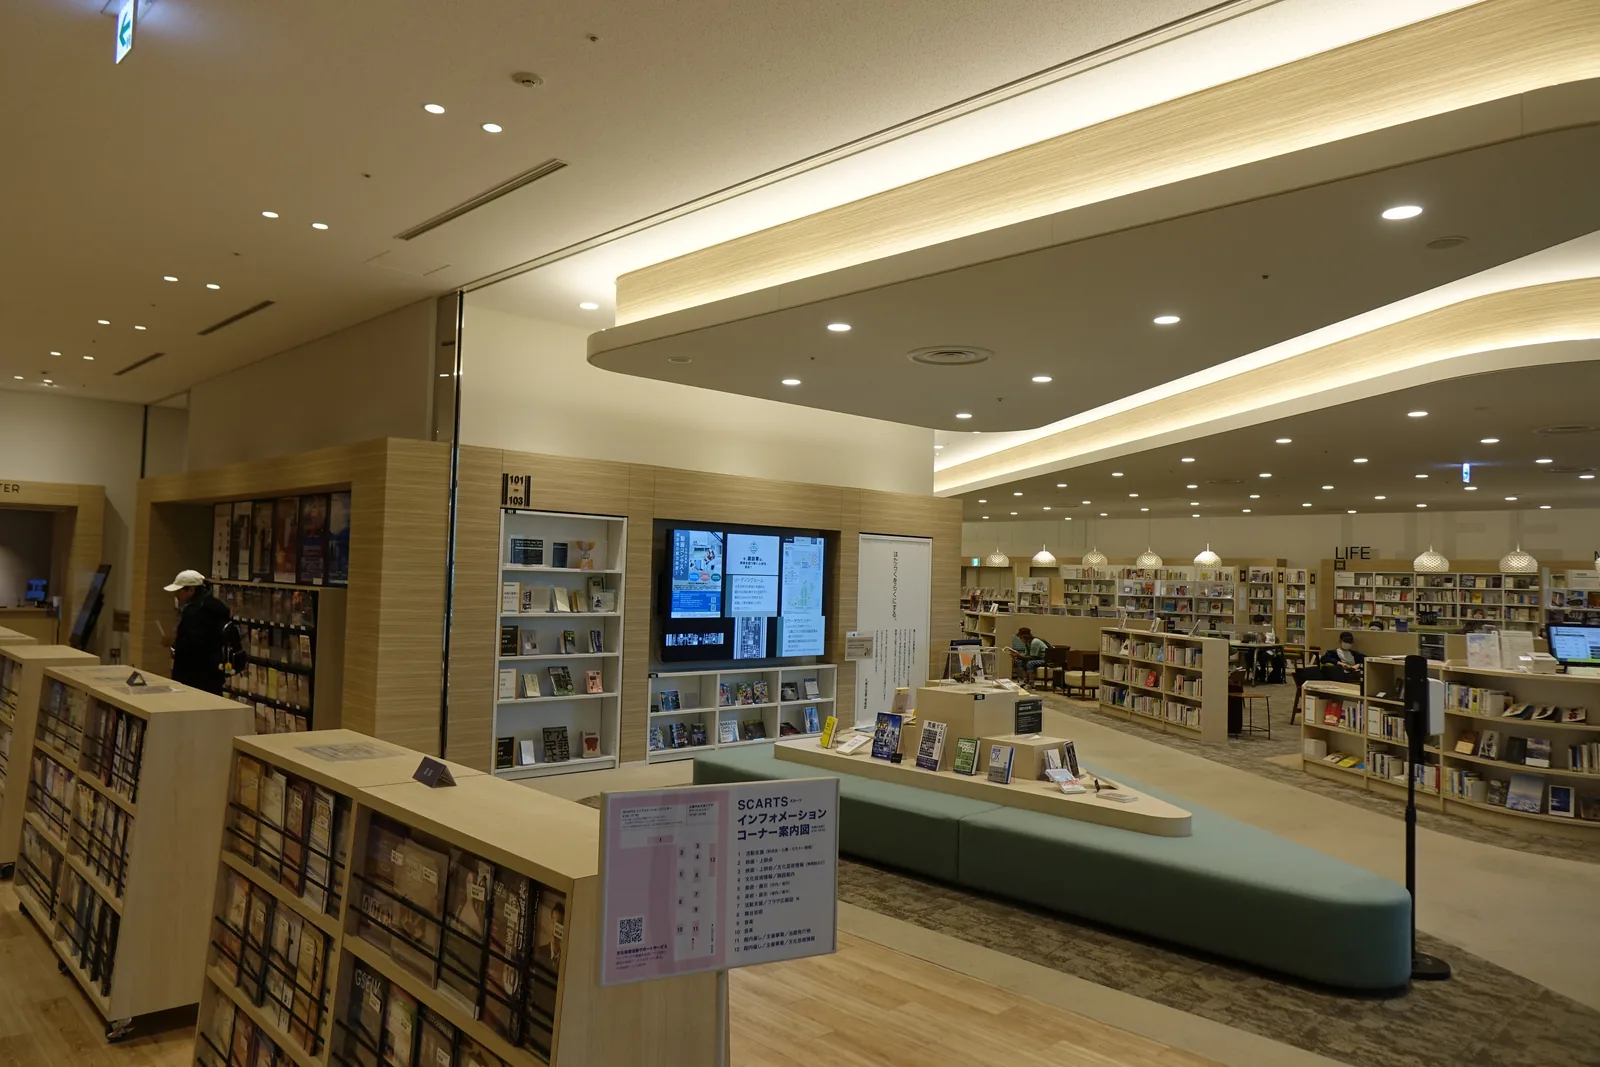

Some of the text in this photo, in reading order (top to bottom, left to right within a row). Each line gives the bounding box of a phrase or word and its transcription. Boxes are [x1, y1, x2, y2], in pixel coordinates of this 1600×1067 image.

[510, 475, 523, 484] 101
[509, 496, 523, 505] 103
[1335, 546, 1371, 560] LIFE
[738, 796, 789, 811] SCARTS
[738, 809, 827, 826] インフォメーション
[738, 824, 810, 841] コーナー案内図
